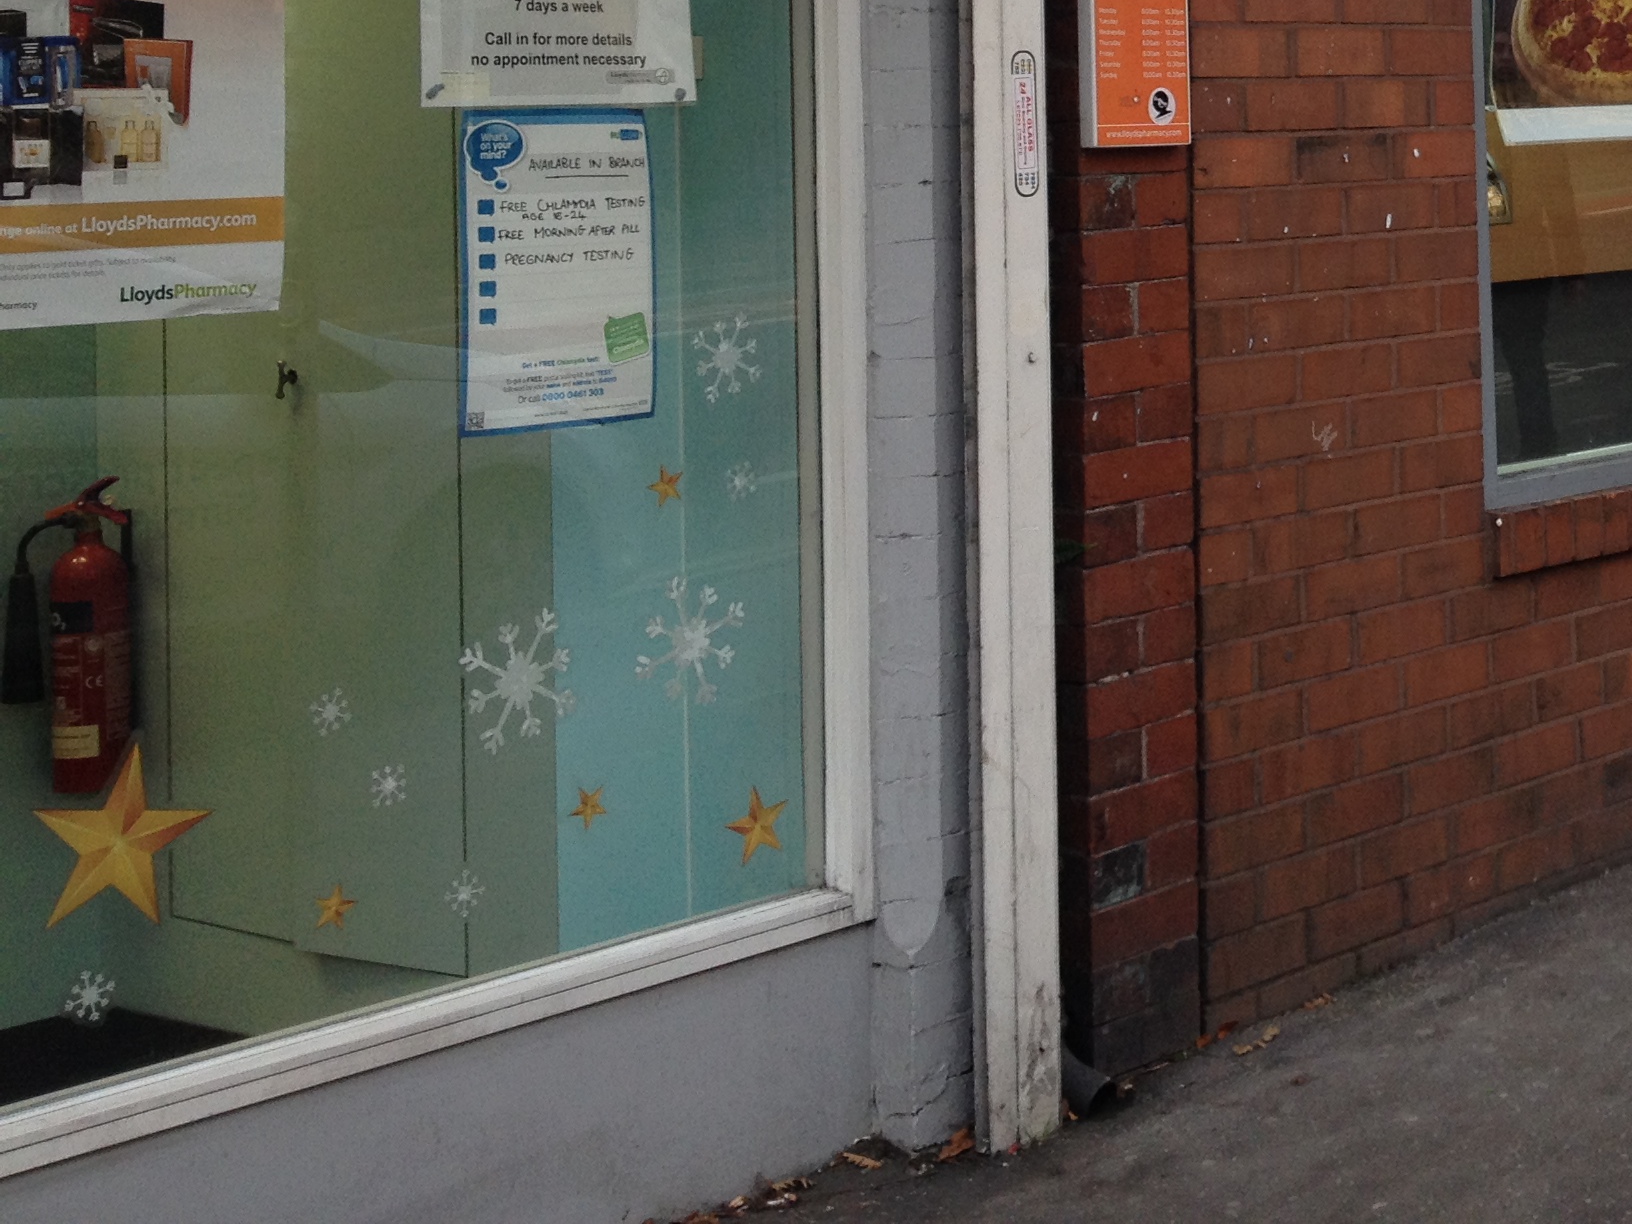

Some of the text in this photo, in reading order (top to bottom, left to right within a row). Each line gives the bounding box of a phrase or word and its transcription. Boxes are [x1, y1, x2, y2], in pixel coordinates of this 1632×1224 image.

[514, 0, 522, 11] 7
[561, 2, 569, 12] a
[572, 0, 604, 13] week
[485, 32, 633, 46] Call in for more details
[471, 52, 647, 70] no appointment necessary
[480, 141, 512, 153] on your
[528, 156, 645, 172] AVAILABLE IN BRANCH
[499, 196, 646, 213] FREE CHLAMYDIA TESTING
[25, 223, 62, 235] online
[65, 223, 78, 234] at
[81, 211, 257, 236] LloydsPharmacy.com
[497, 223, 641, 242] FREE MORNING AFTER PILL
[504, 248, 635, 267] PREGNANCY TESTING
[120, 281, 257, 306] LloydsPharmacy
